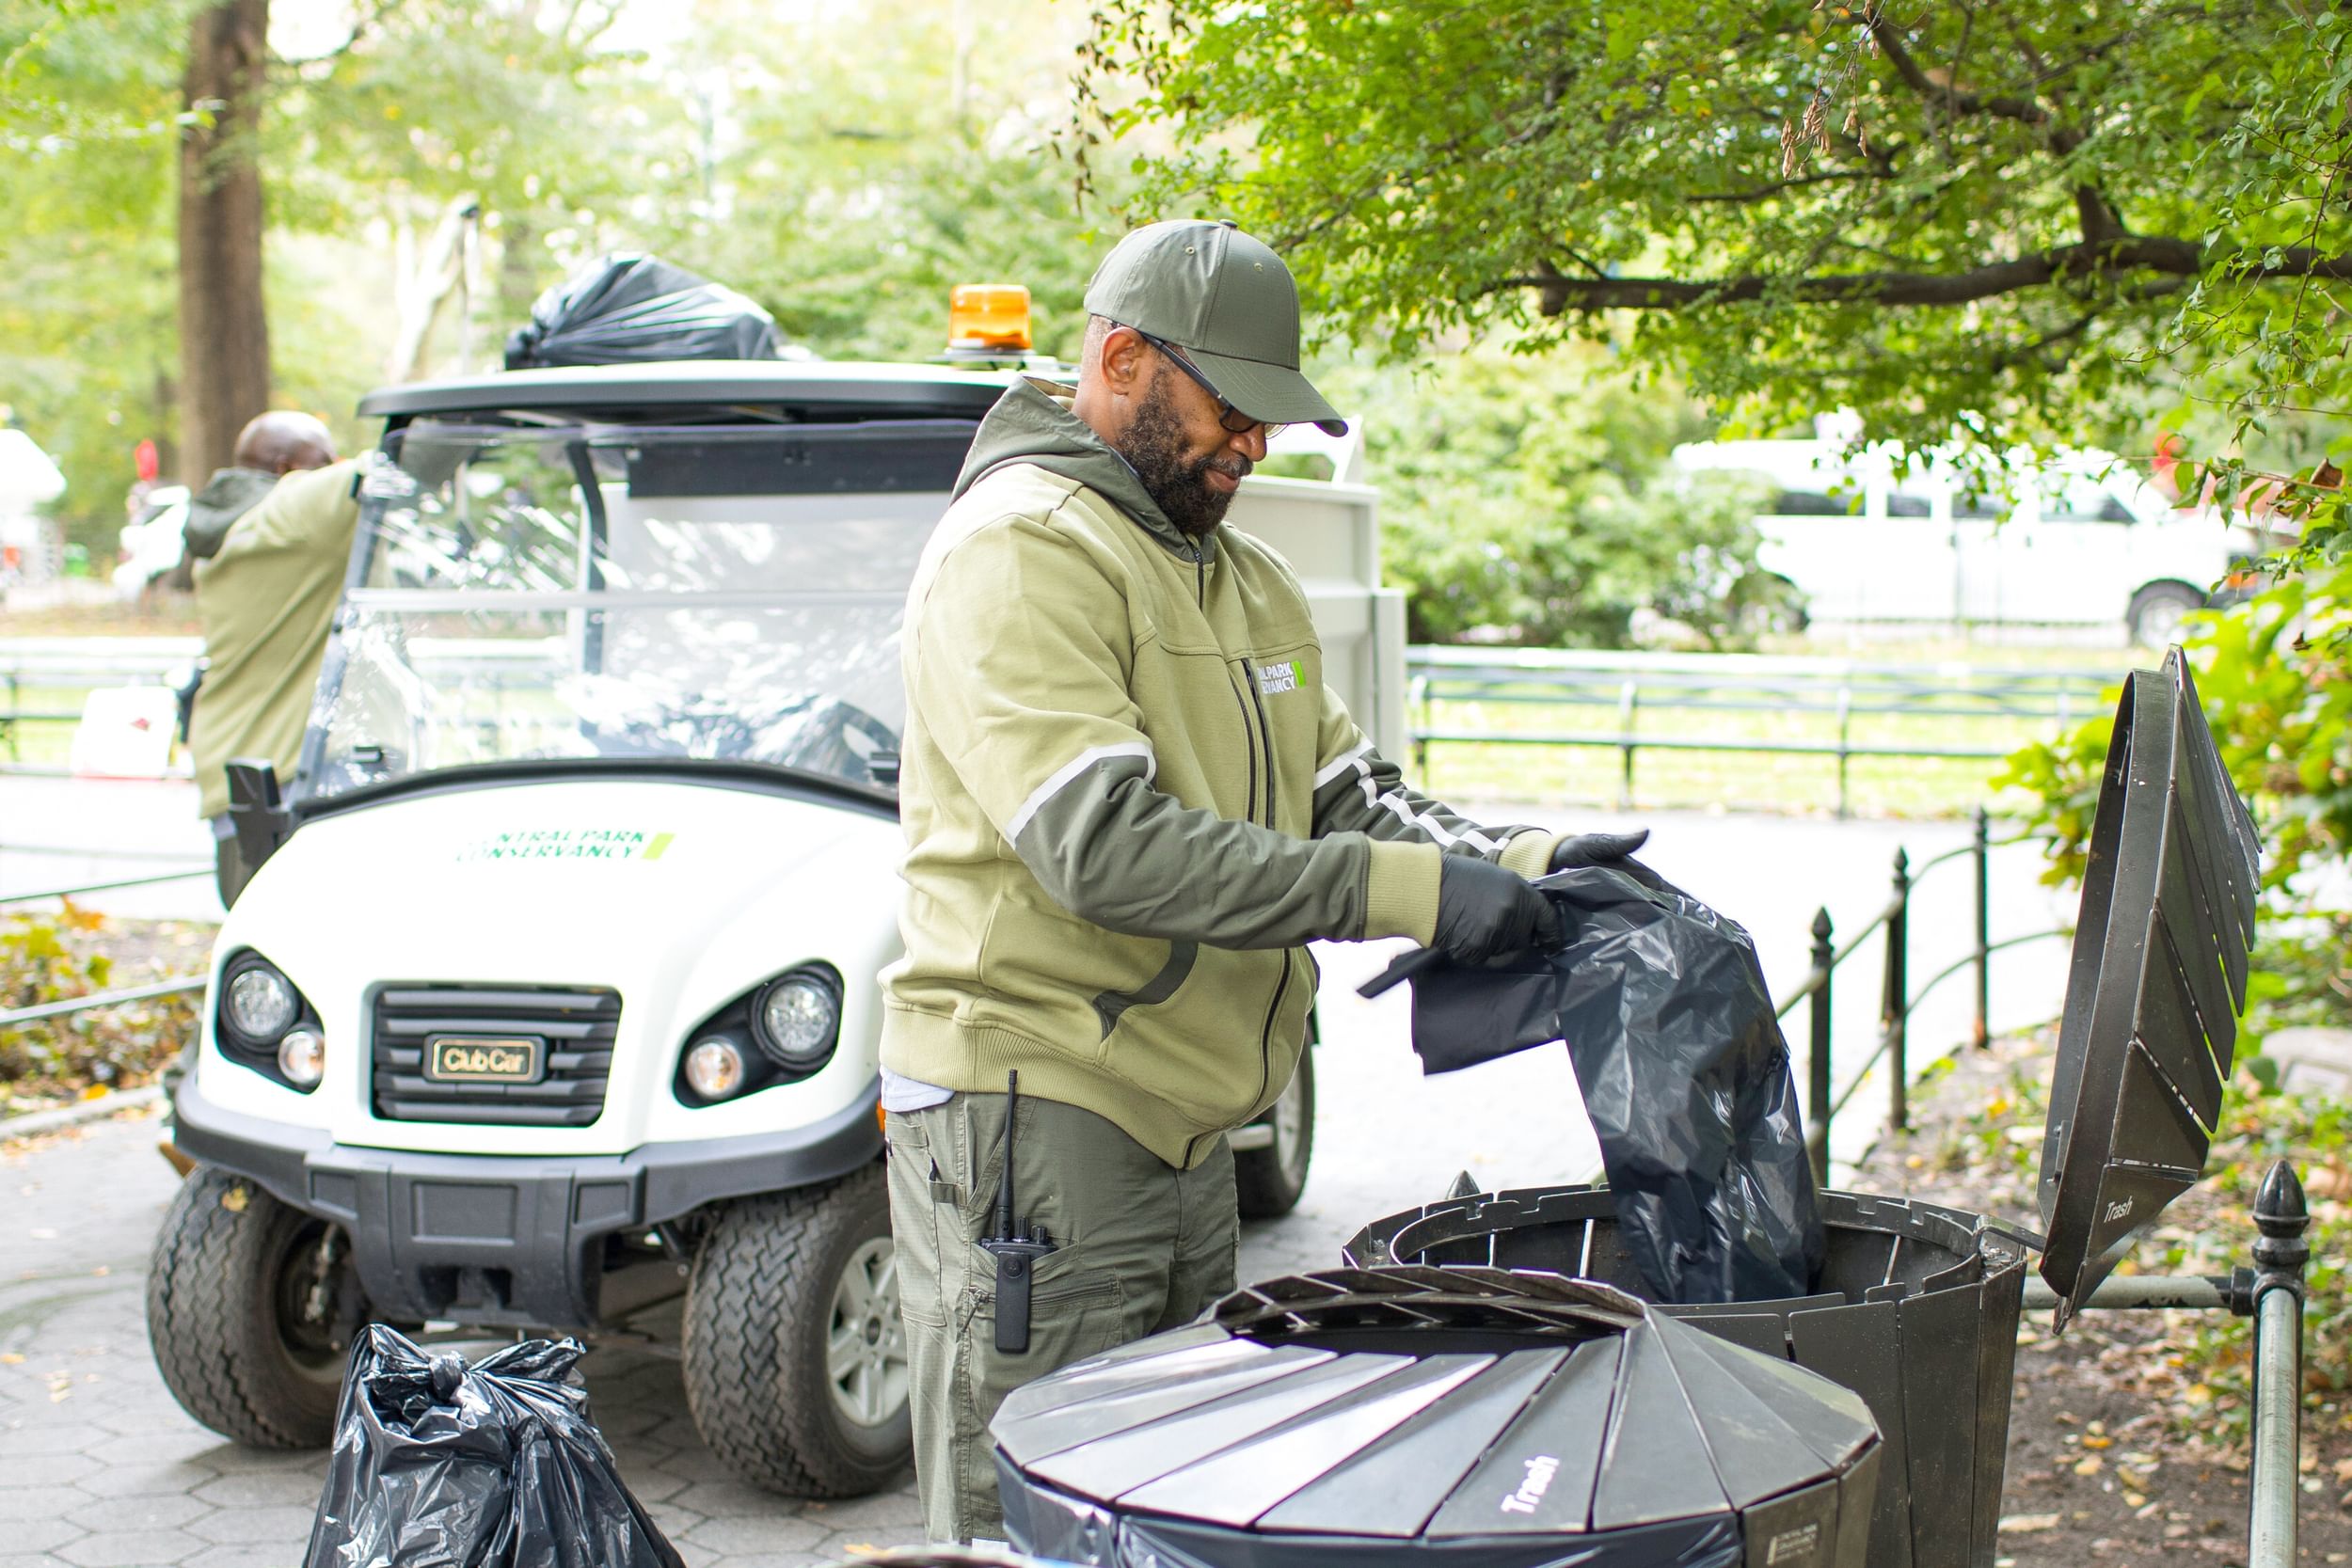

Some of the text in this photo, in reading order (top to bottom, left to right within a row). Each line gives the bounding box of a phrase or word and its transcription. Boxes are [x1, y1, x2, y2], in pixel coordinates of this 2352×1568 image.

[1265, 661, 1294, 679] PARK
[1261, 676, 1295, 694] RVANCY
[496, 830, 646, 844] NTRAL PARK
[455, 844, 636, 862] NSERVANCY
[2104, 1195, 2133, 1223] Trash
[1501, 1455, 1559, 1513] Trash
